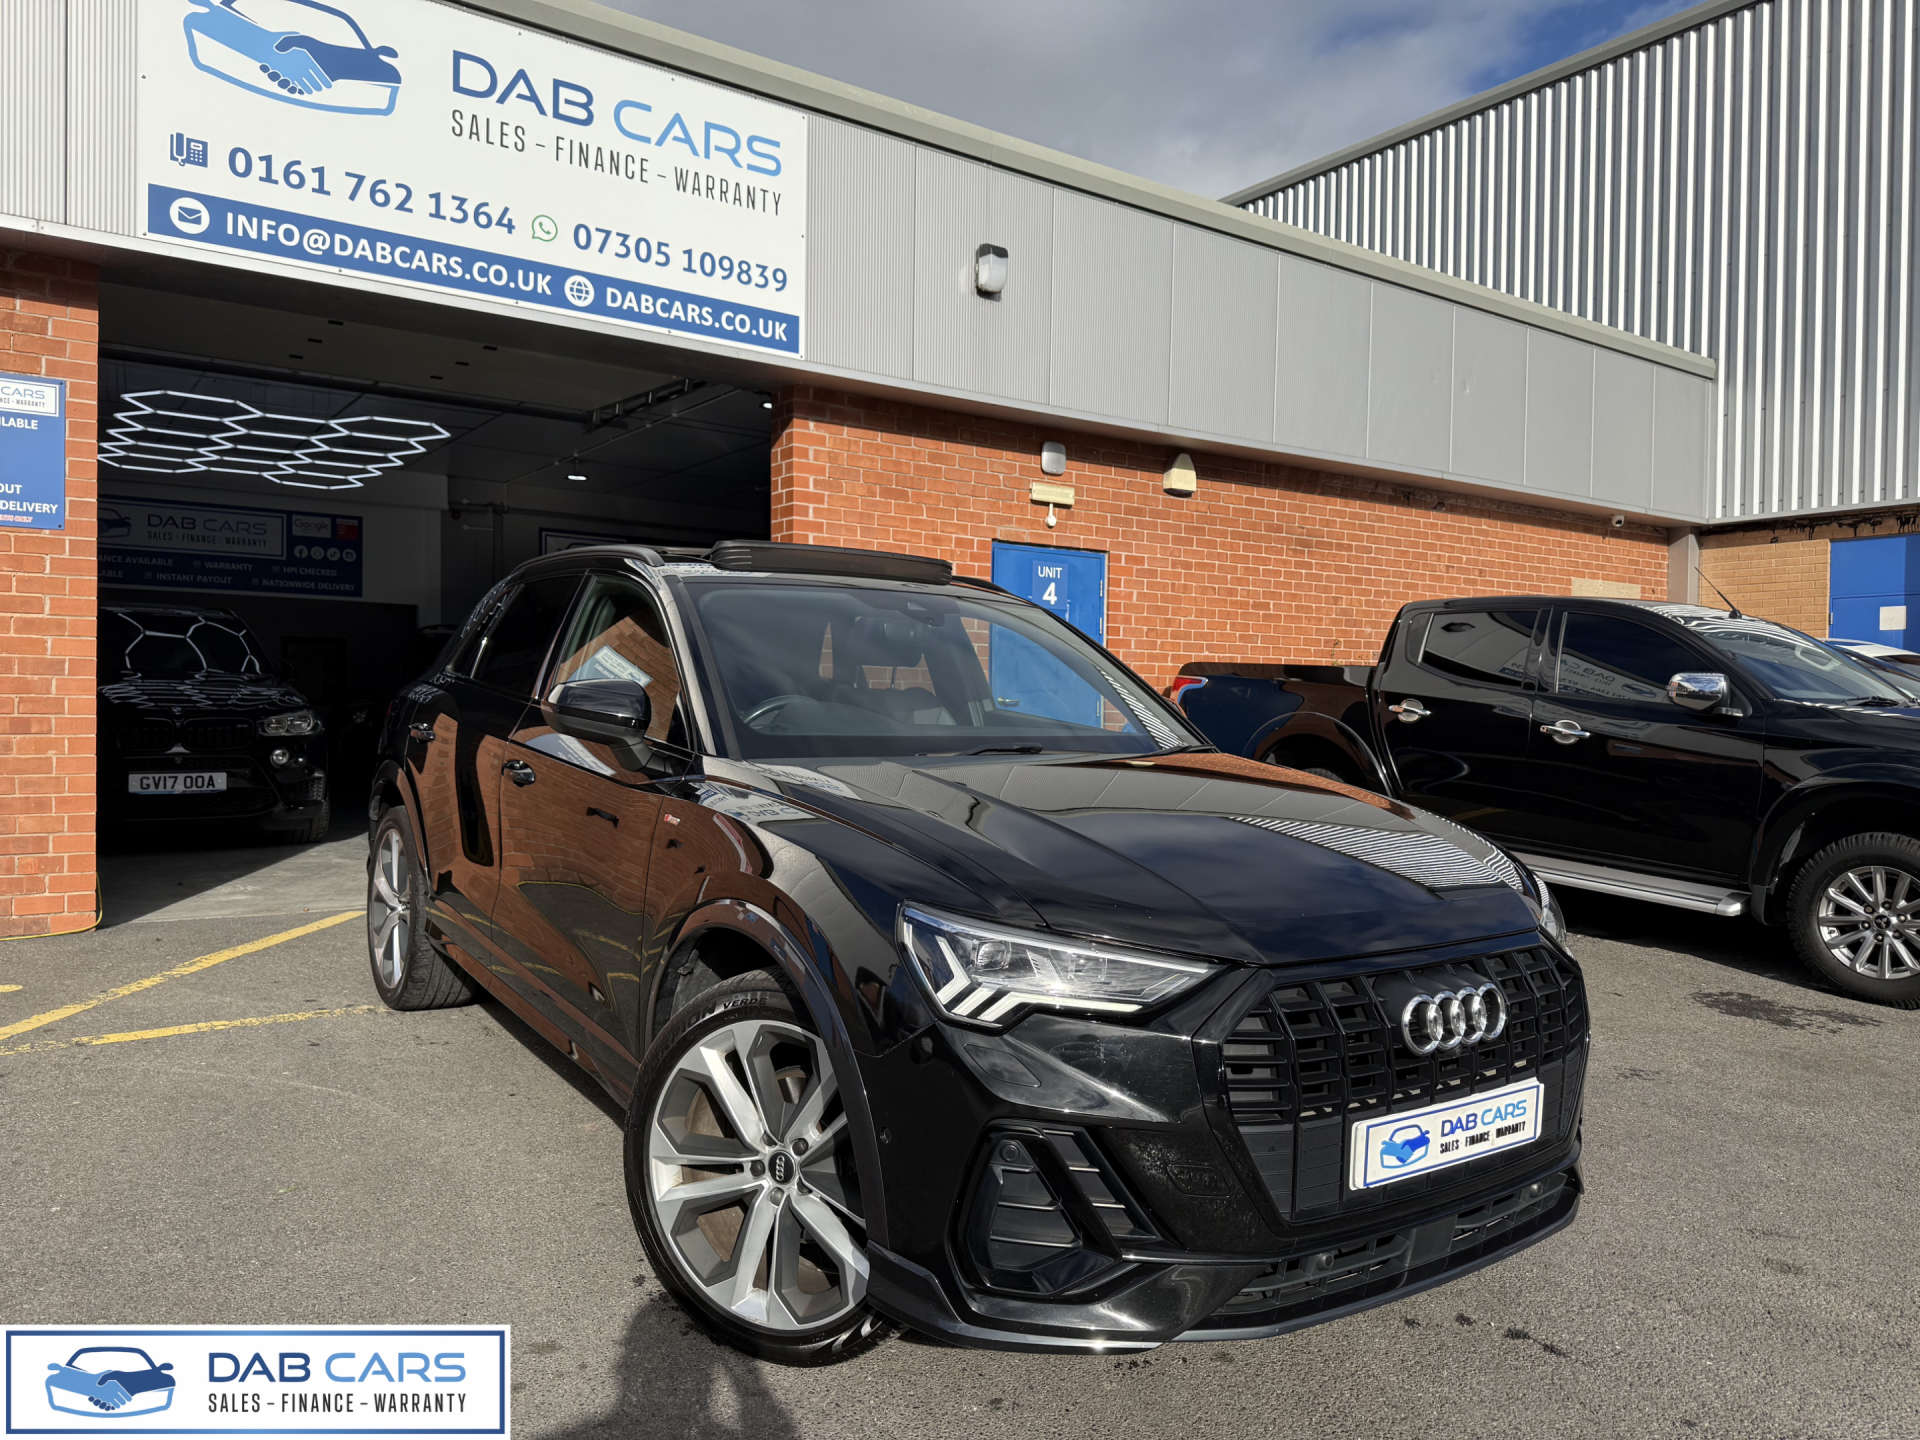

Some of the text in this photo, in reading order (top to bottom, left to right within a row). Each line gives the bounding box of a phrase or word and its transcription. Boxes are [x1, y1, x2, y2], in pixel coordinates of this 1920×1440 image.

[453, 50, 782, 176] DAB CARS
[452, 109, 525, 152] SALES
[556, 136, 649, 183] FINANCE
[674, 167, 782, 216] WARRANTY
[228, 147, 516, 234] 0161 762 1364
[226, 212, 552, 296] INFO@DABCARS.CO.UK
[573, 223, 788, 292] 07305 109839
[606, 287, 788, 341] DABCARS.CO.UK
[1, 386, 45, 399] CARS
[0, 500, 58, 514] DELIVERY
[147, 513, 267, 535] DAB CARS
[1038, 565, 1062, 579] UNIT
[1042, 582, 1057, 605] 4
[140, 775, 178, 790] GV17
[1441, 1099, 1527, 1137] DAB CARS
[1440, 1139, 1459, 1154] SALES
[1465, 1130, 1490, 1147] FINANCE
